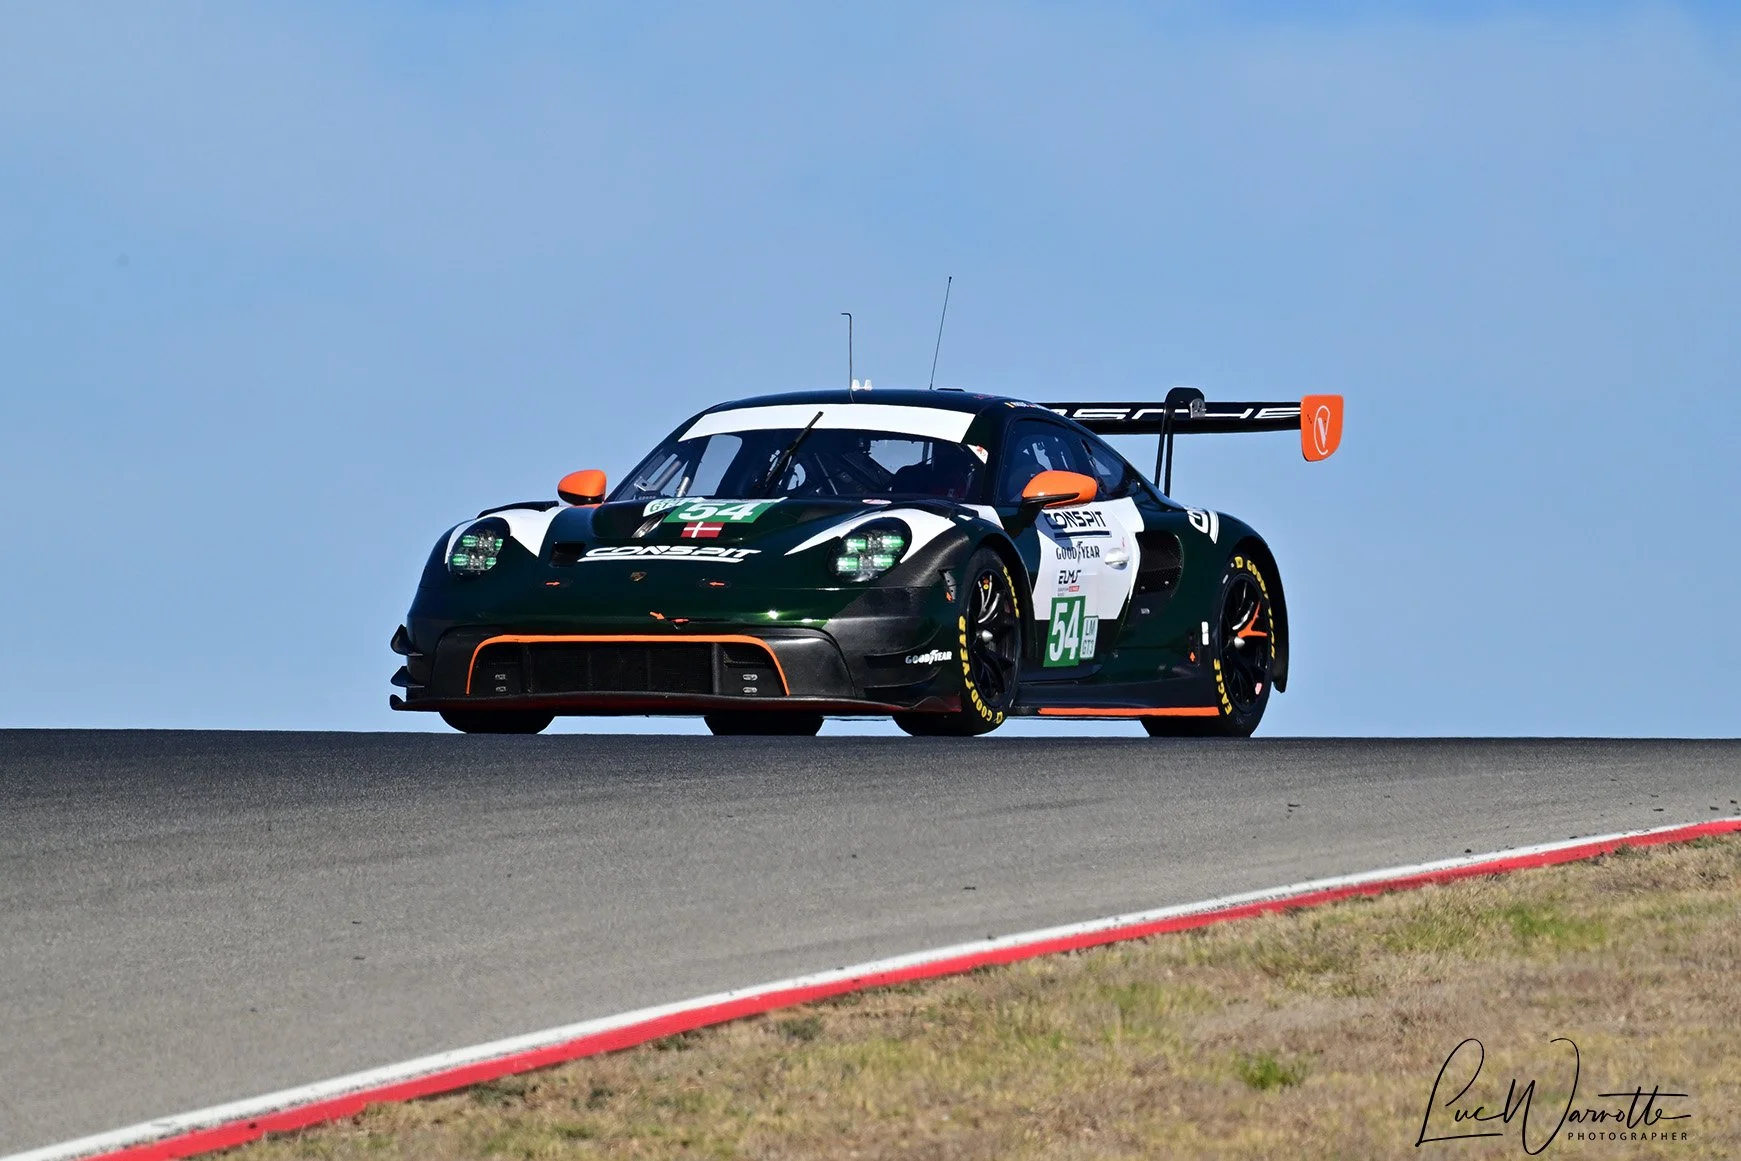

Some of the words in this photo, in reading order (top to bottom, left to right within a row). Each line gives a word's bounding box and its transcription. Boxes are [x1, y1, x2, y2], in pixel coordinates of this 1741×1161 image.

[678, 502, 757, 521] 54
[1044, 511, 1107, 530] CONSPIT
[583, 545, 762, 560] CONSPIT
[1055, 541, 1101, 563] GOODYEAR
[1050, 600, 1081, 662] 54
[1085, 619, 1096, 636] LM
[905, 649, 953, 664] GOODYEAR
[1213, 658, 1233, 716] EAGLE
